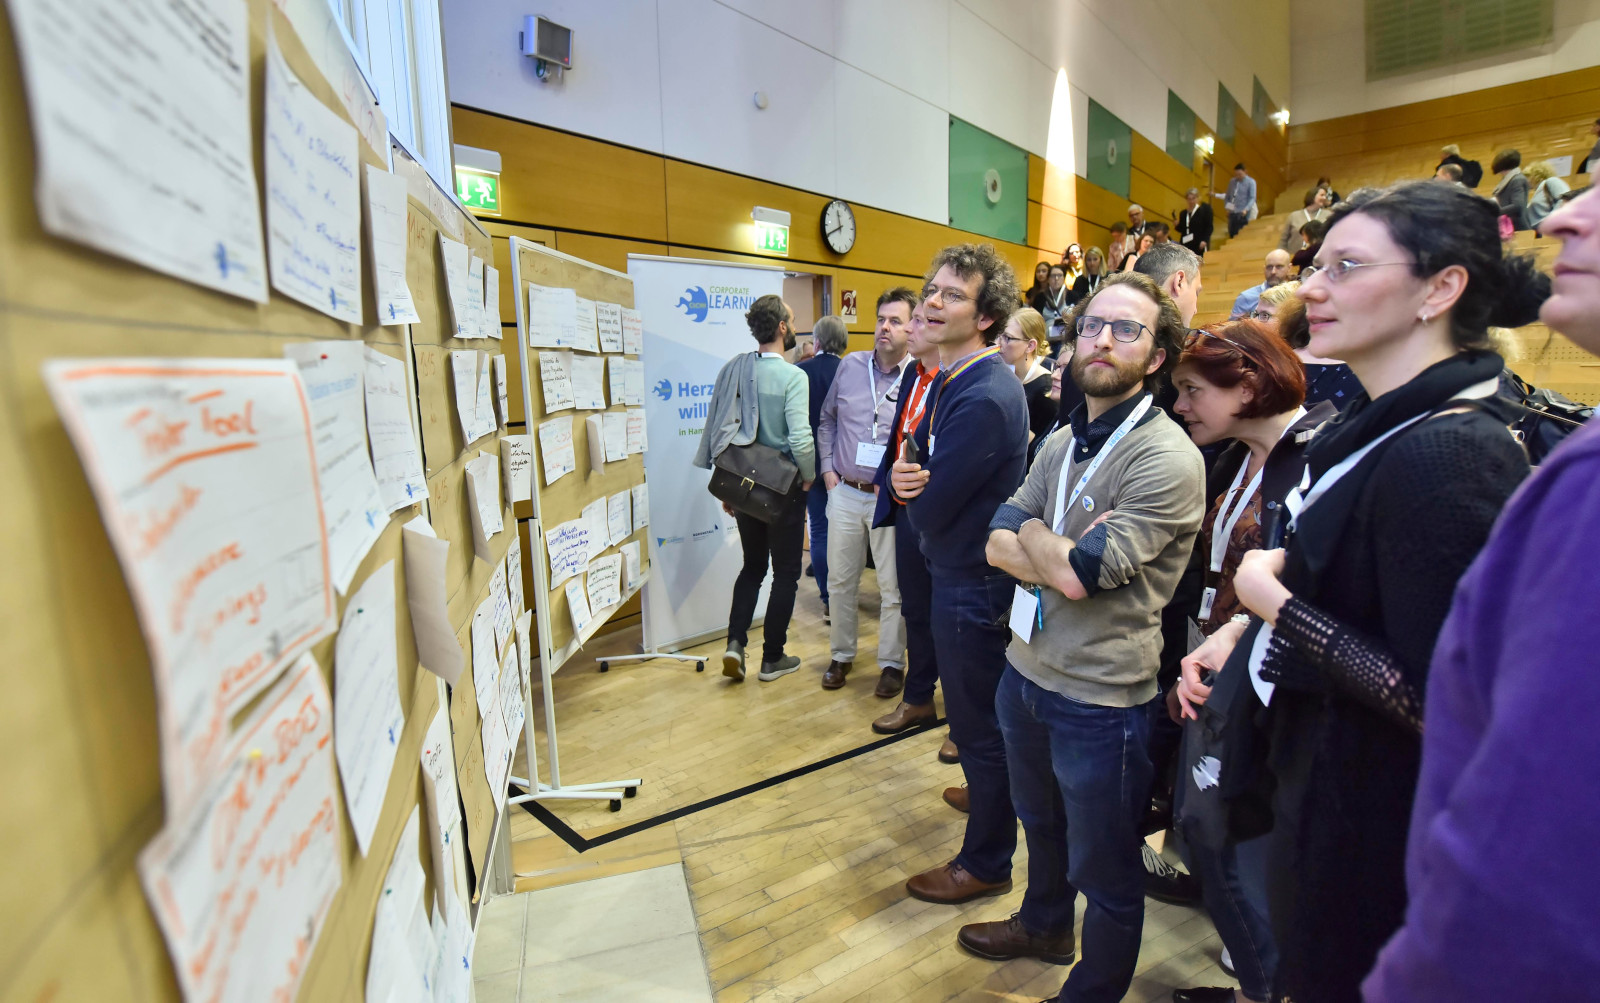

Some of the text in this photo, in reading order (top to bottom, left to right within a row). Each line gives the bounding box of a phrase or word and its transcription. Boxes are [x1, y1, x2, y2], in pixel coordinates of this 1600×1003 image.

[709, 286, 750, 295] CORPORATE
[678, 382, 715, 398] Herz
[678, 402, 711, 420] will
[679, 428, 687, 436] in
